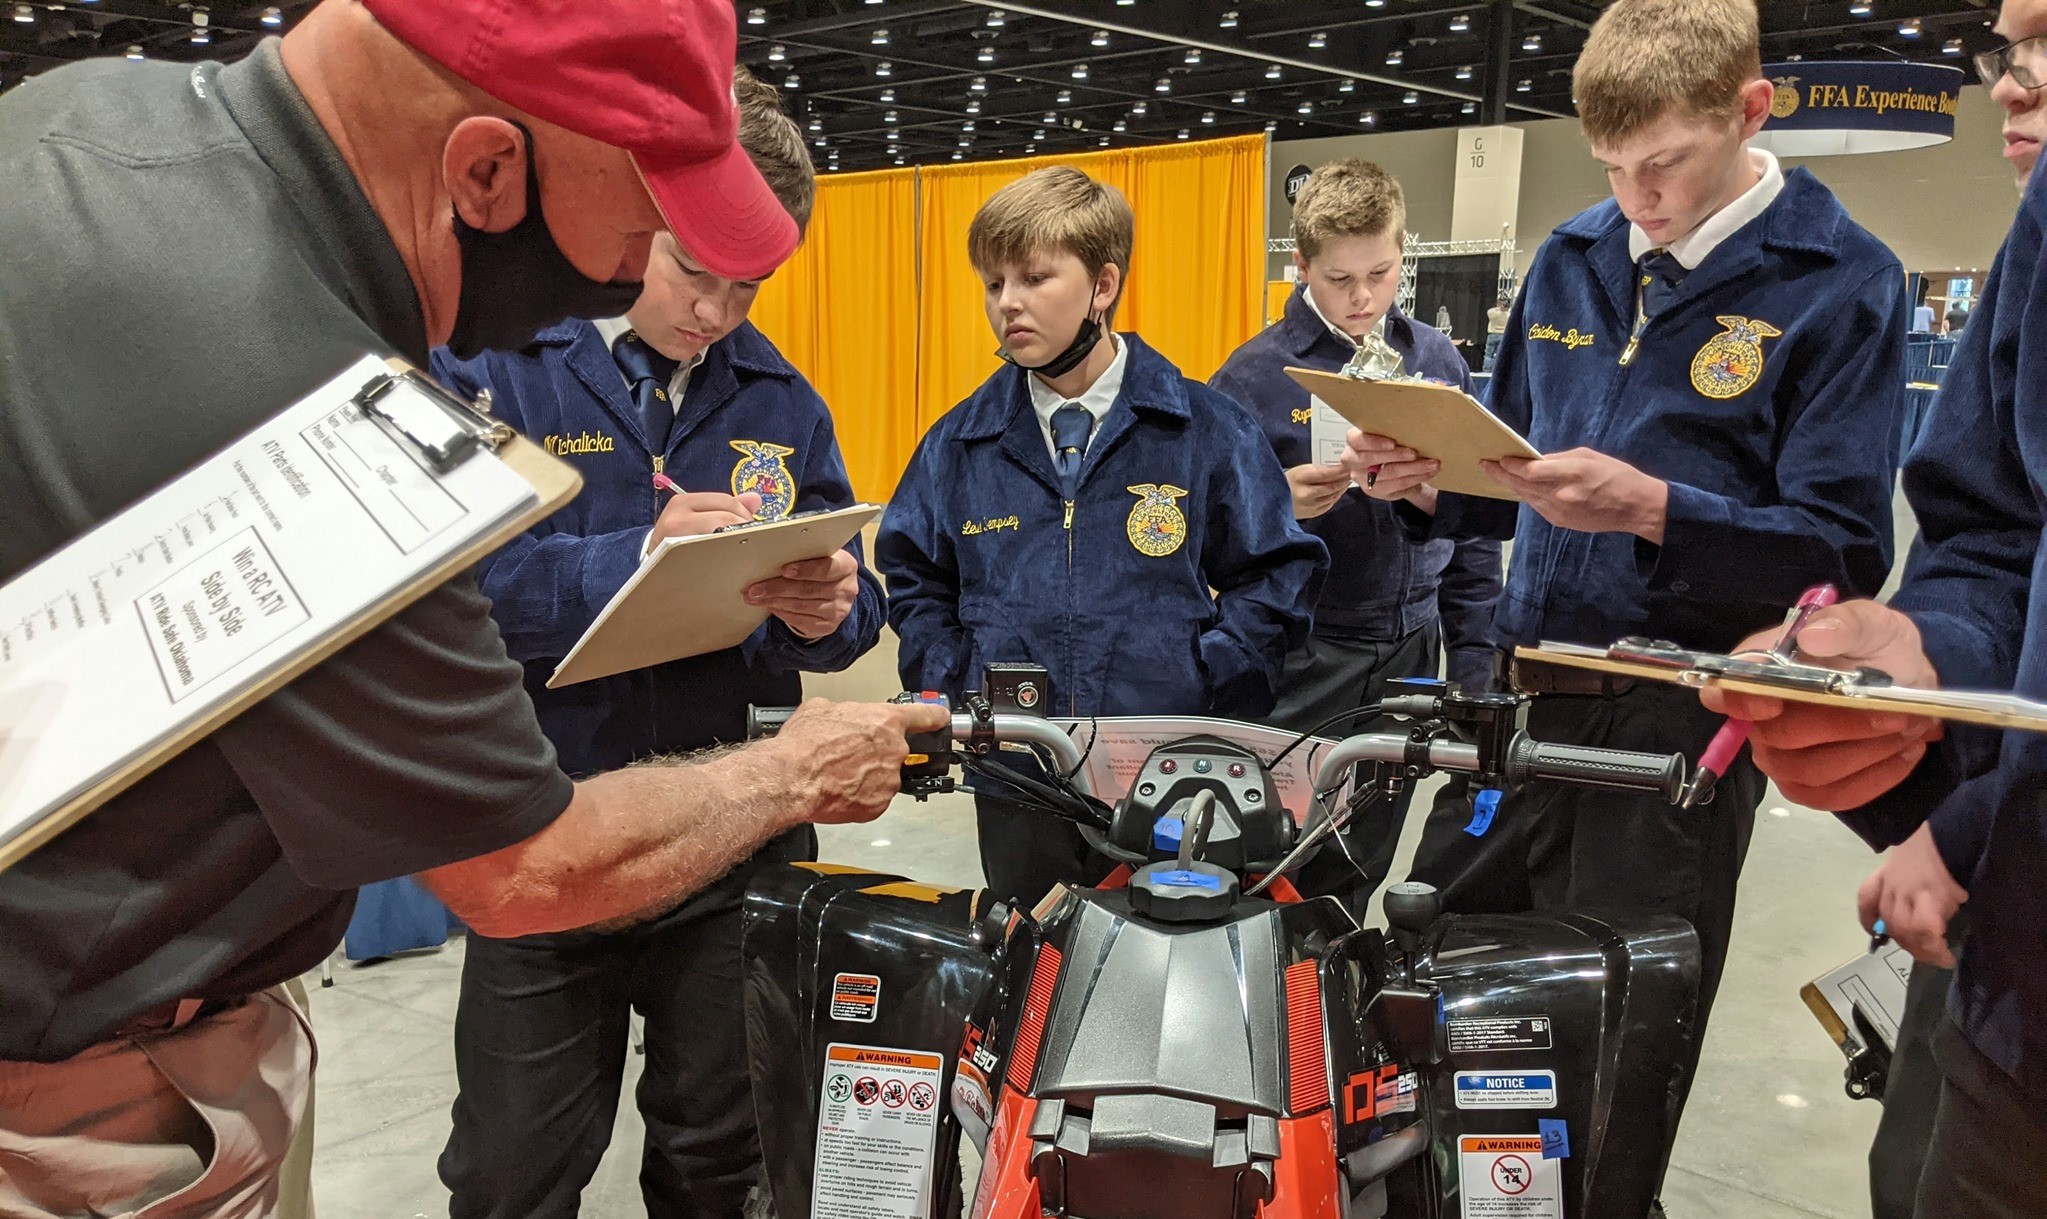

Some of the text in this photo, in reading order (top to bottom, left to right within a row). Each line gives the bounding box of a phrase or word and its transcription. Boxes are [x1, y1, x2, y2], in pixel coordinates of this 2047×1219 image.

[1808, 85, 1849, 108] FFA
[1853, 85, 1937, 115] Experience
[1474, 137, 1483, 151] G
[1470, 155, 1484, 169] 10
[261, 440, 280, 458] ATV
[272, 450, 289, 472] Parts
[232, 546, 288, 617] Win a RC ATV
[201, 571, 247, 637] Side by Side
[181, 600, 208, 637] Sponsored
[149, 592, 194, 686] ATV Ride Safe Oklahoma
[866, 1053, 911, 1064] WARNING
[972, 1044, 999, 1074] 250
[1397, 1071, 1418, 1095] 250
[1486, 1078, 1525, 1088] NOTICE
[1488, 1141, 1541, 1149] WARNING
[1503, 1175, 1520, 1184] 14
